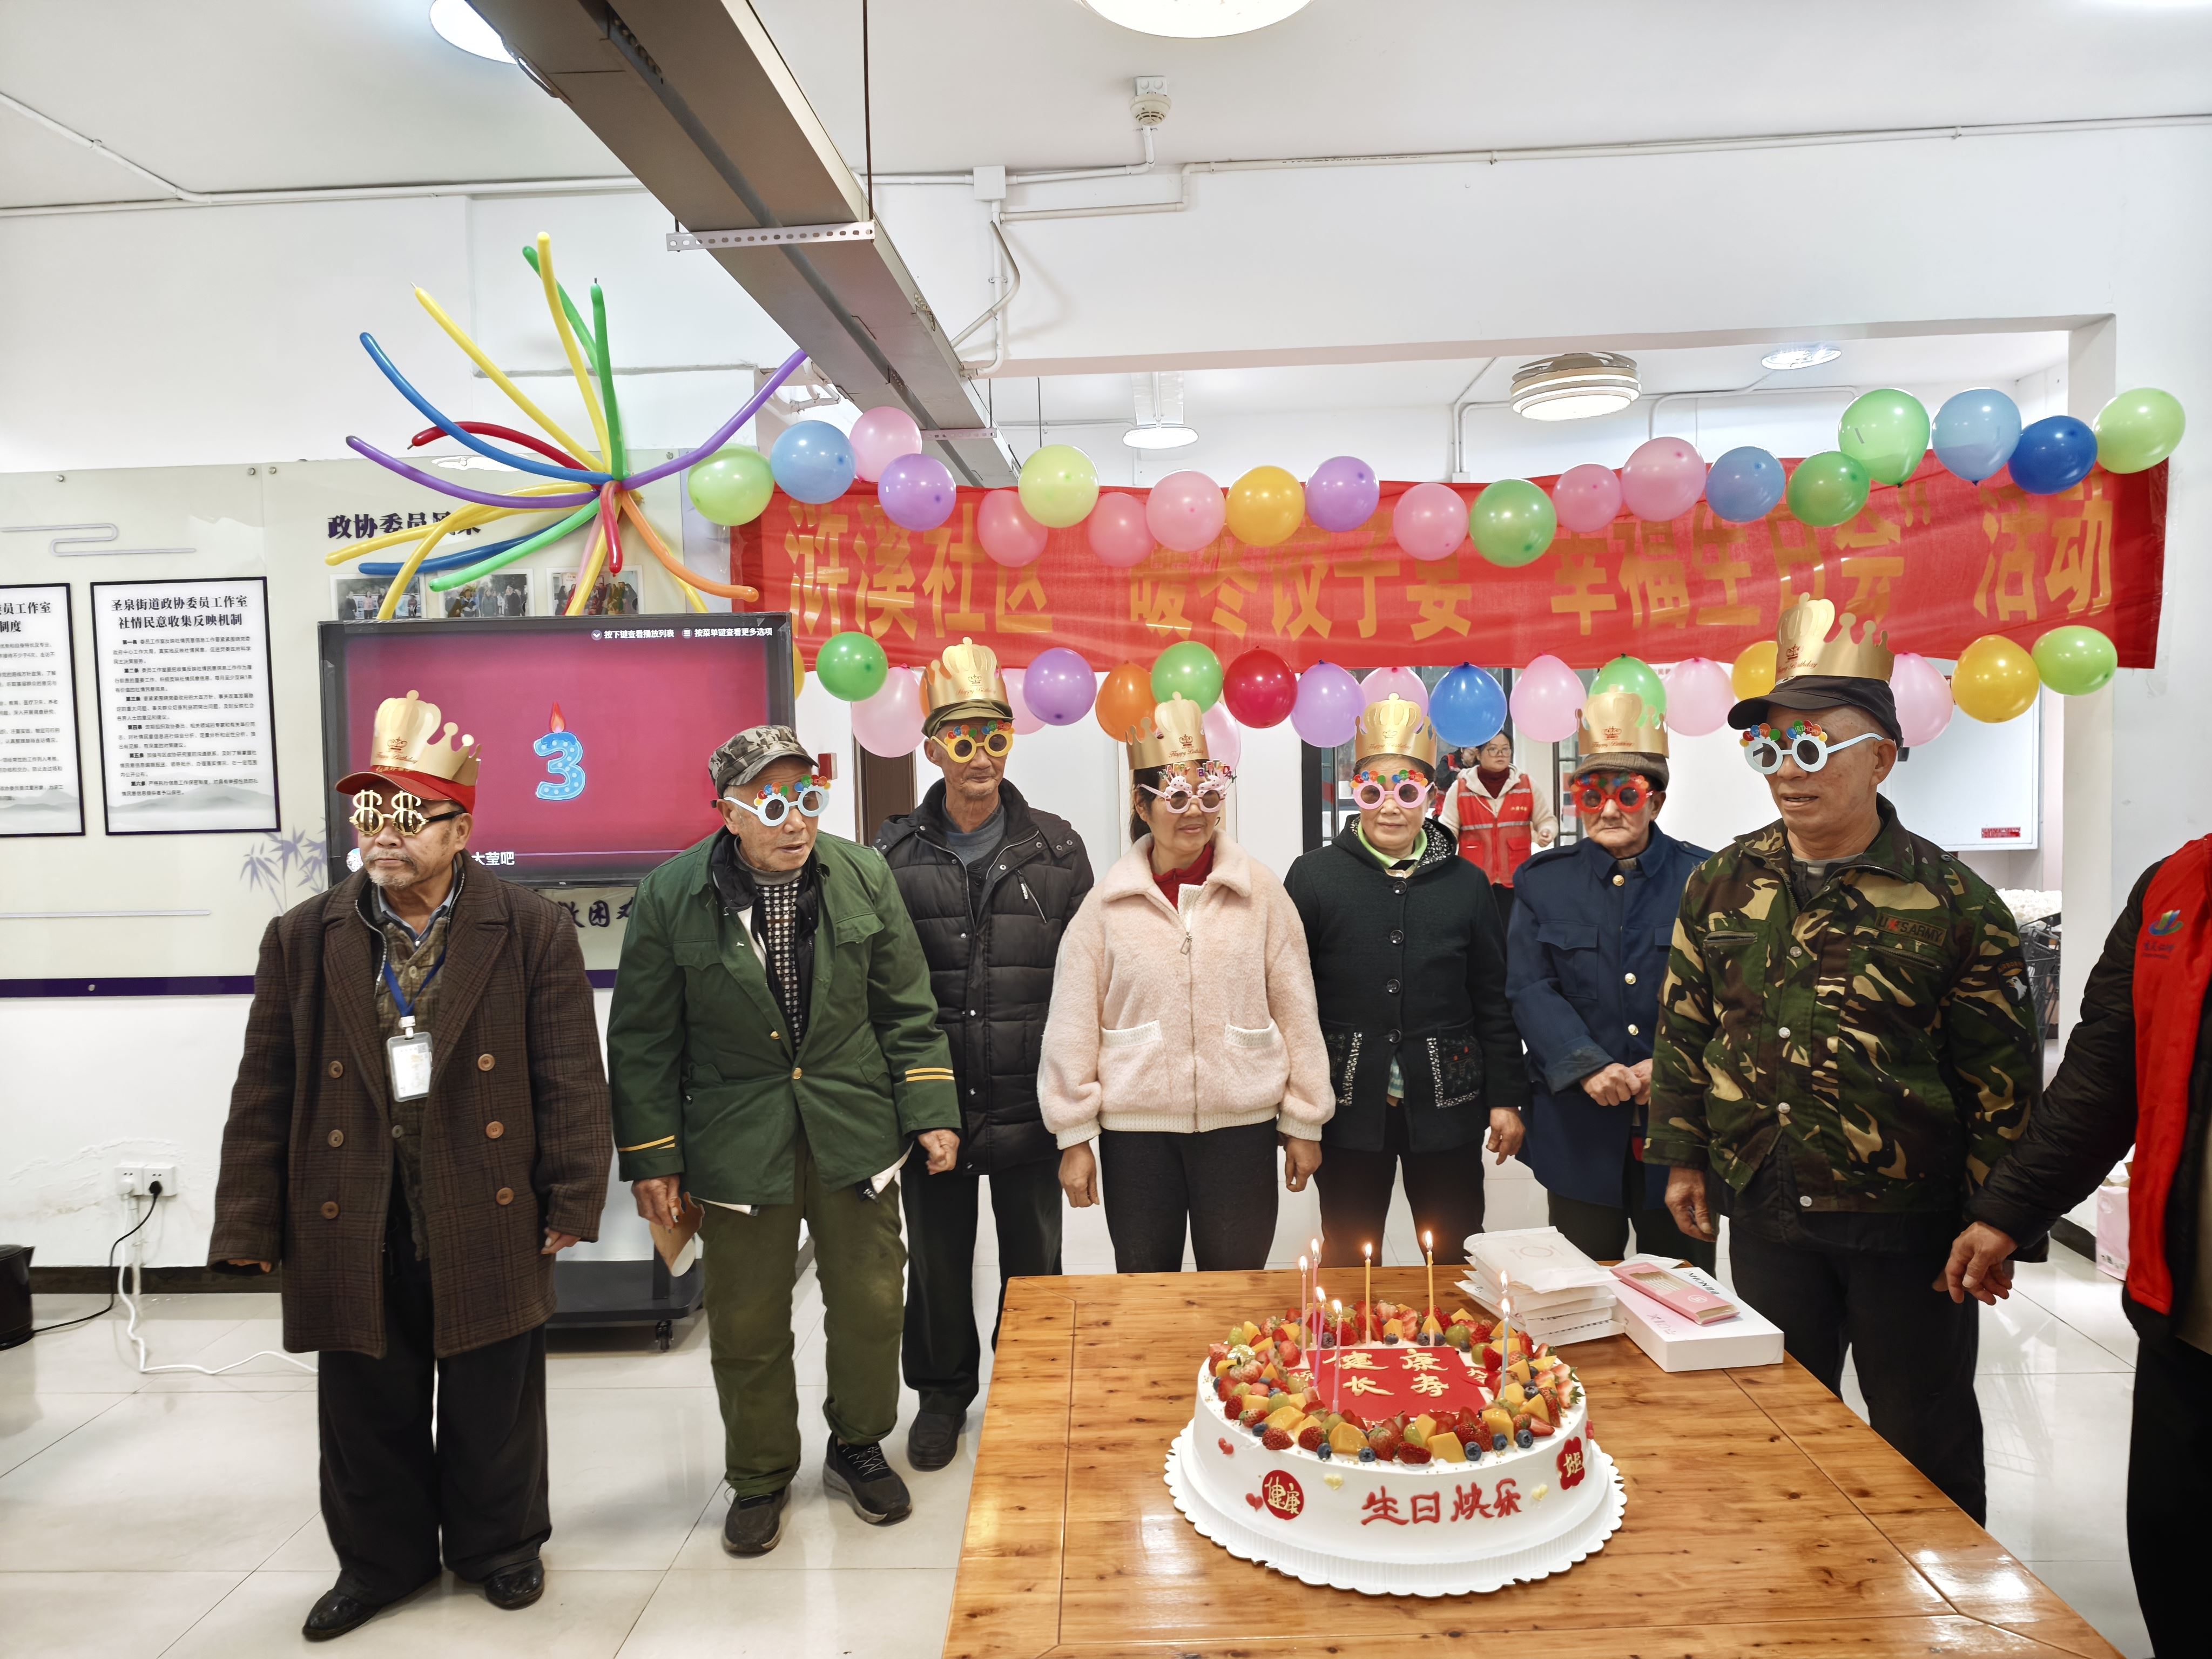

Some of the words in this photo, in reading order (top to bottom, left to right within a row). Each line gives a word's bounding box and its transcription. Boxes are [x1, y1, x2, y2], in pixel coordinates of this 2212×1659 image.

[1974, 471, 2113, 621] 活动
[111, 595, 248, 611] 圣泉街道政协委员工作室
[119, 613, 242, 629] 社情民意收集反映机制
[604, 630, 675, 639] 按下键查看播放列表
[694, 628, 773, 637] 按菜单键查看更多选项
[1343, 1373, 1449, 1398] 长寿
[1360, 1478, 1523, 1526] 生日快乐
